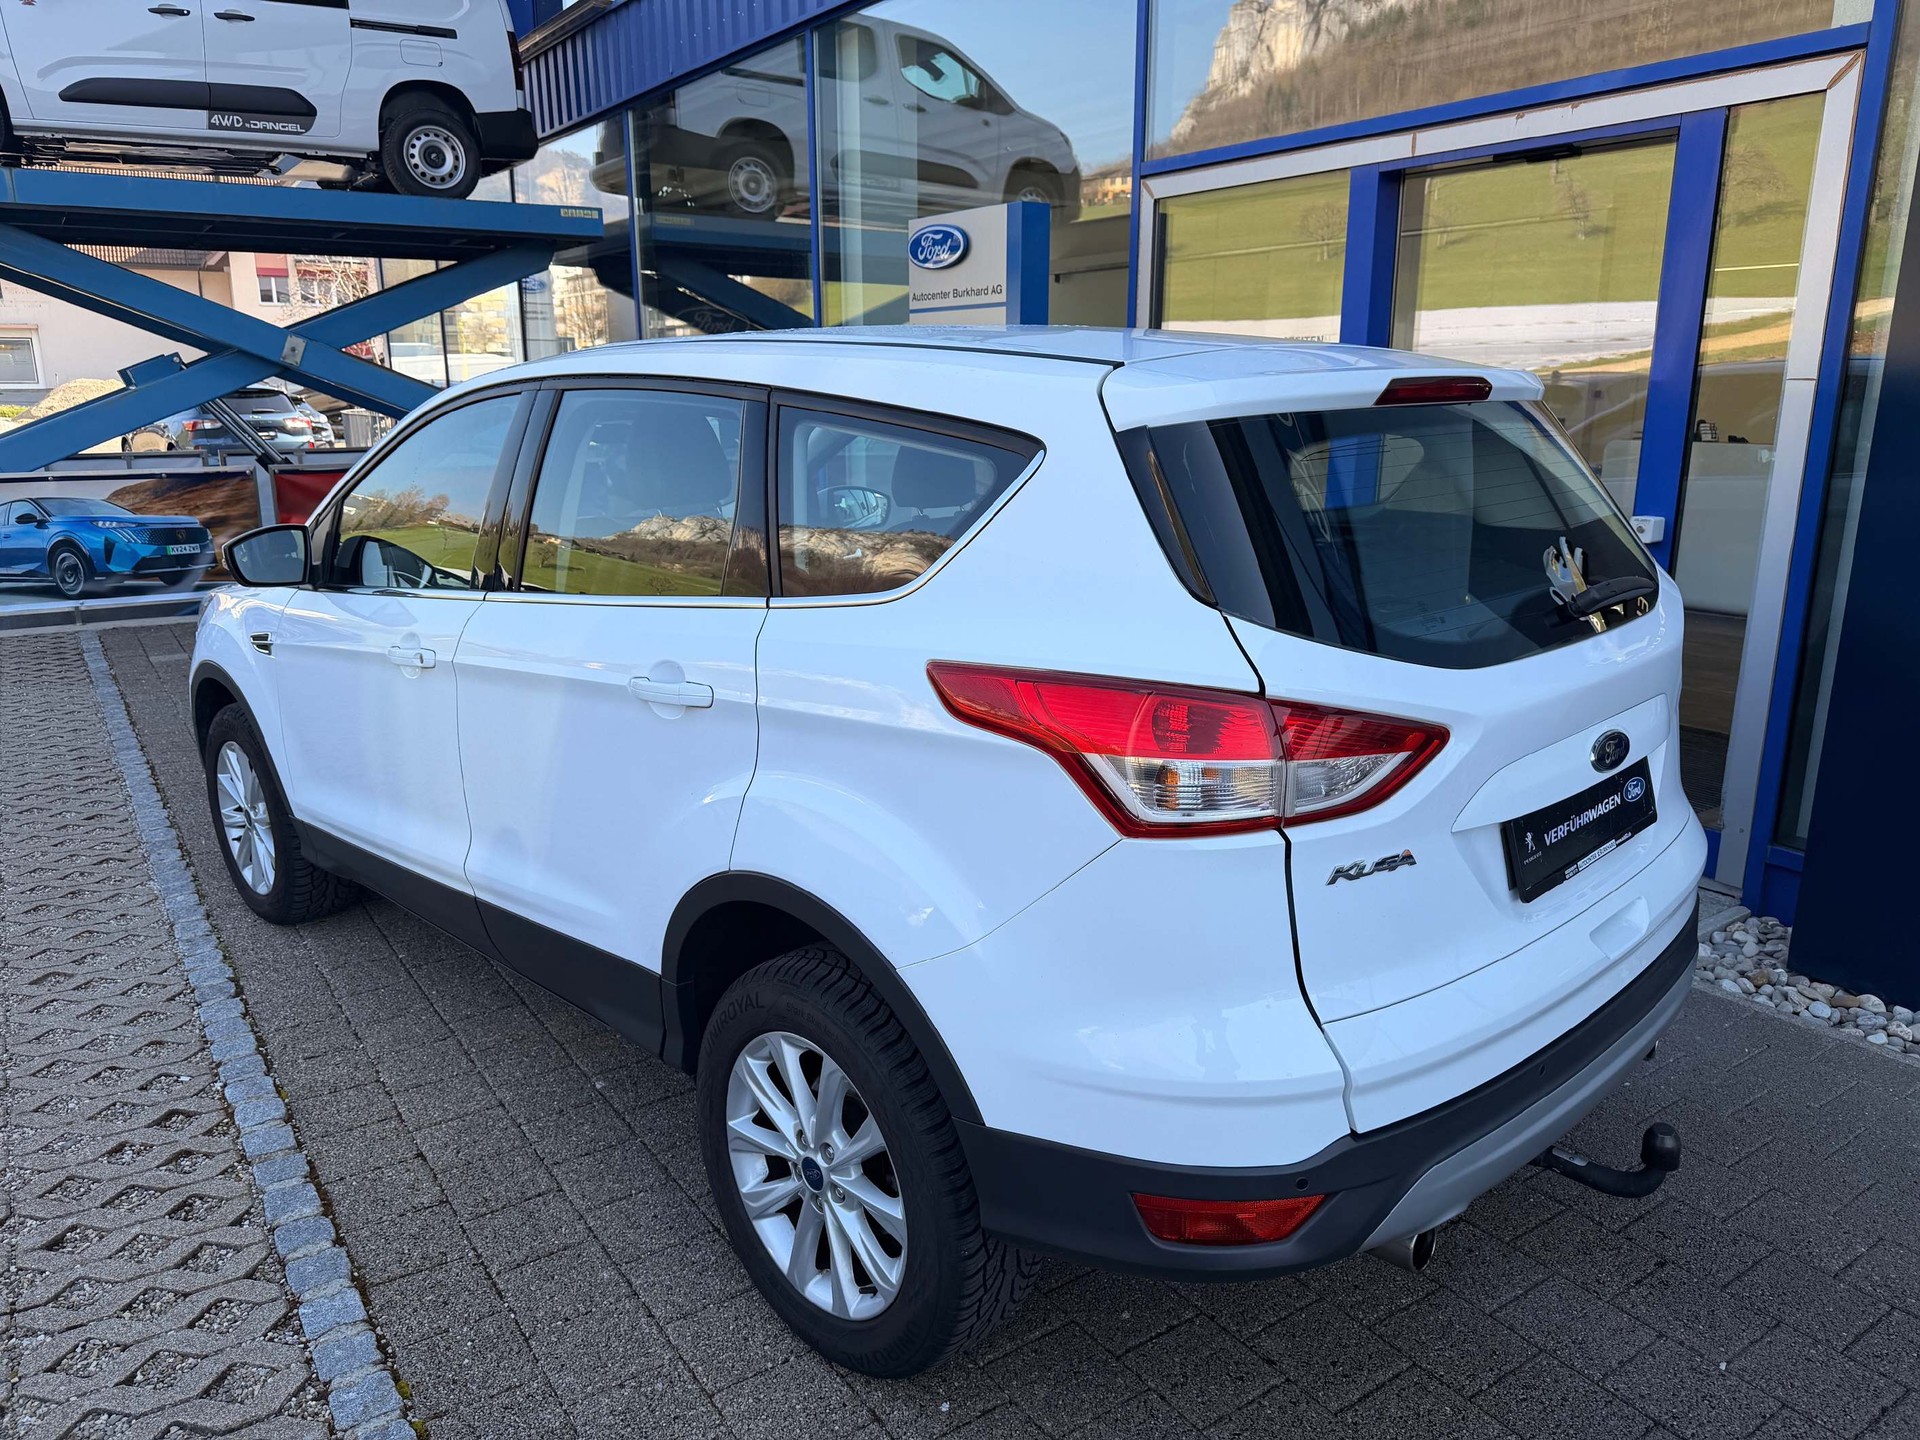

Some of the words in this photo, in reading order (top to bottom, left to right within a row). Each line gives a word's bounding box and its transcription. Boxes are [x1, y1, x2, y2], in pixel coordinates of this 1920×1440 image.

[210, 114, 243, 128] 4WD
[250, 120, 306, 132] DANGEL
[917, 232, 952, 261] Ford
[912, 290, 950, 302] Autocenter
[952, 285, 989, 298] Burkhard
[991, 284, 1003, 295] AG
[1604, 740, 1628, 764] Ford
[1628, 781, 1642, 799] Ford
[1543, 792, 1621, 846] VERFÜHRWAGEN
[1325, 848, 1418, 886] KUGA
[704, 991, 766, 1057] UNIROYAL
